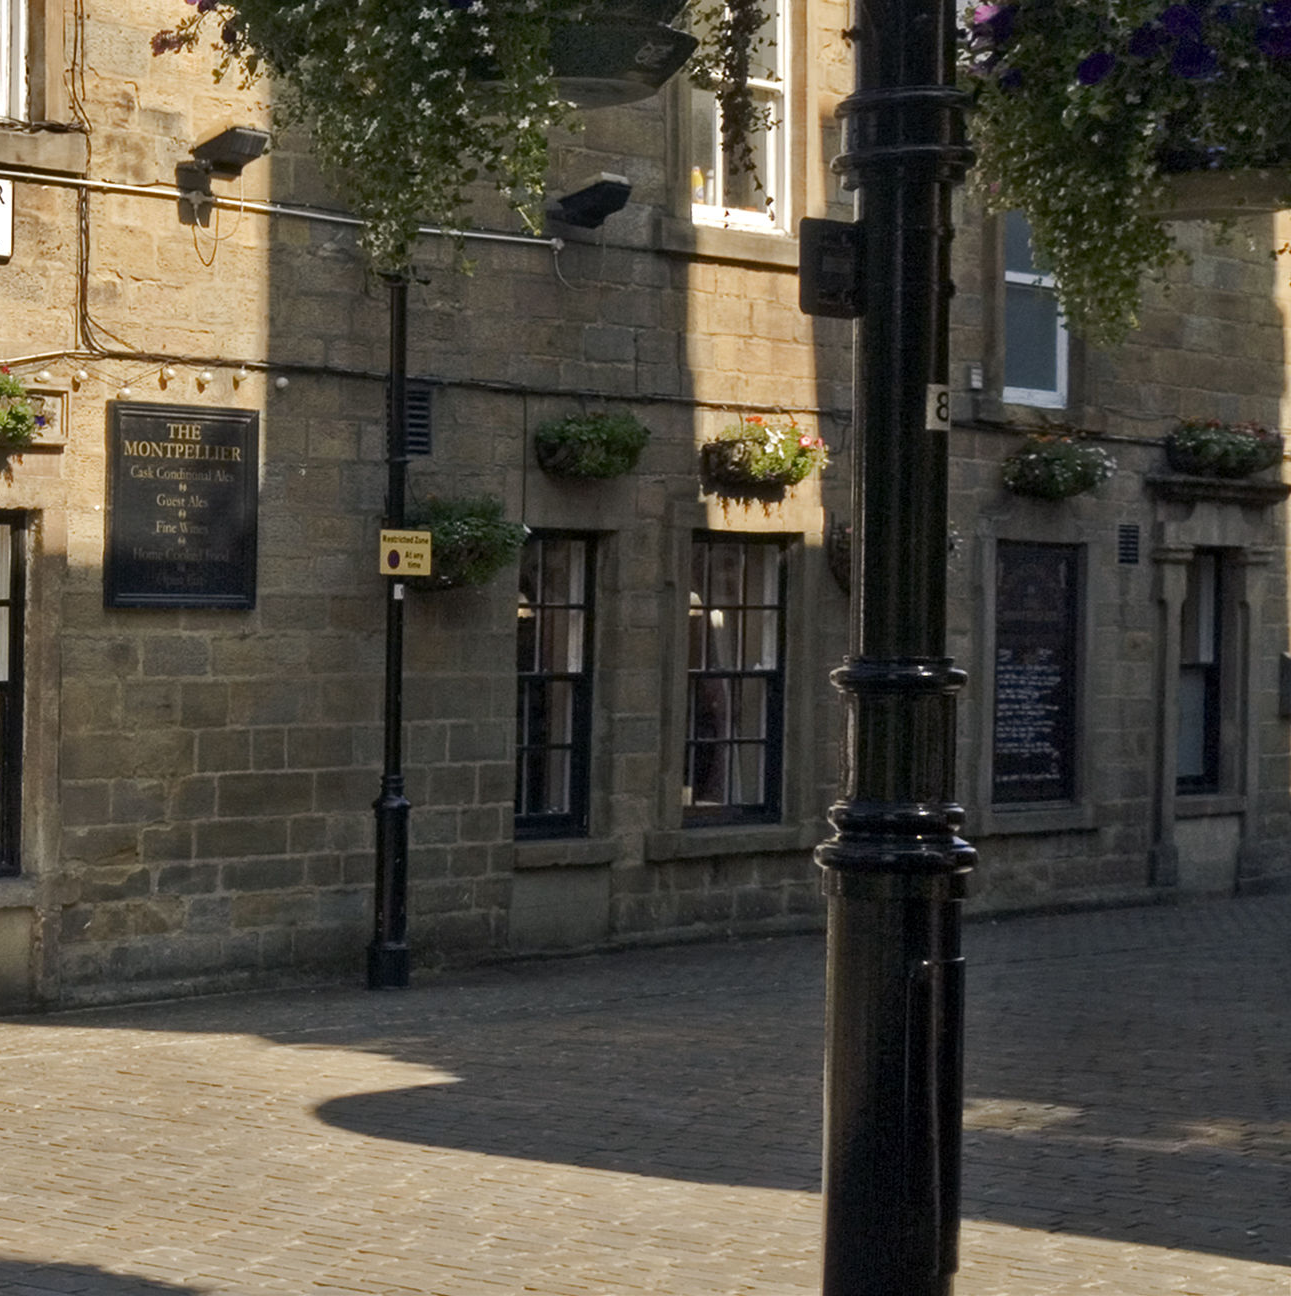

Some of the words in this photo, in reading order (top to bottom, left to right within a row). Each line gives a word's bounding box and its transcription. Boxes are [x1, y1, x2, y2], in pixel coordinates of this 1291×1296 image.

[936, 392, 949, 422] 8
[167, 423, 202, 440] THE
[124, 440, 241, 462] MONTPELLIER
[130, 464, 154, 479] Cask
[156, 494, 185, 508] Guest
[187, 495, 209, 508] Ales
[156, 520, 177, 534] Fine
[382, 535, 413, 544] Restricted
[415, 536, 428, 544] Zone
